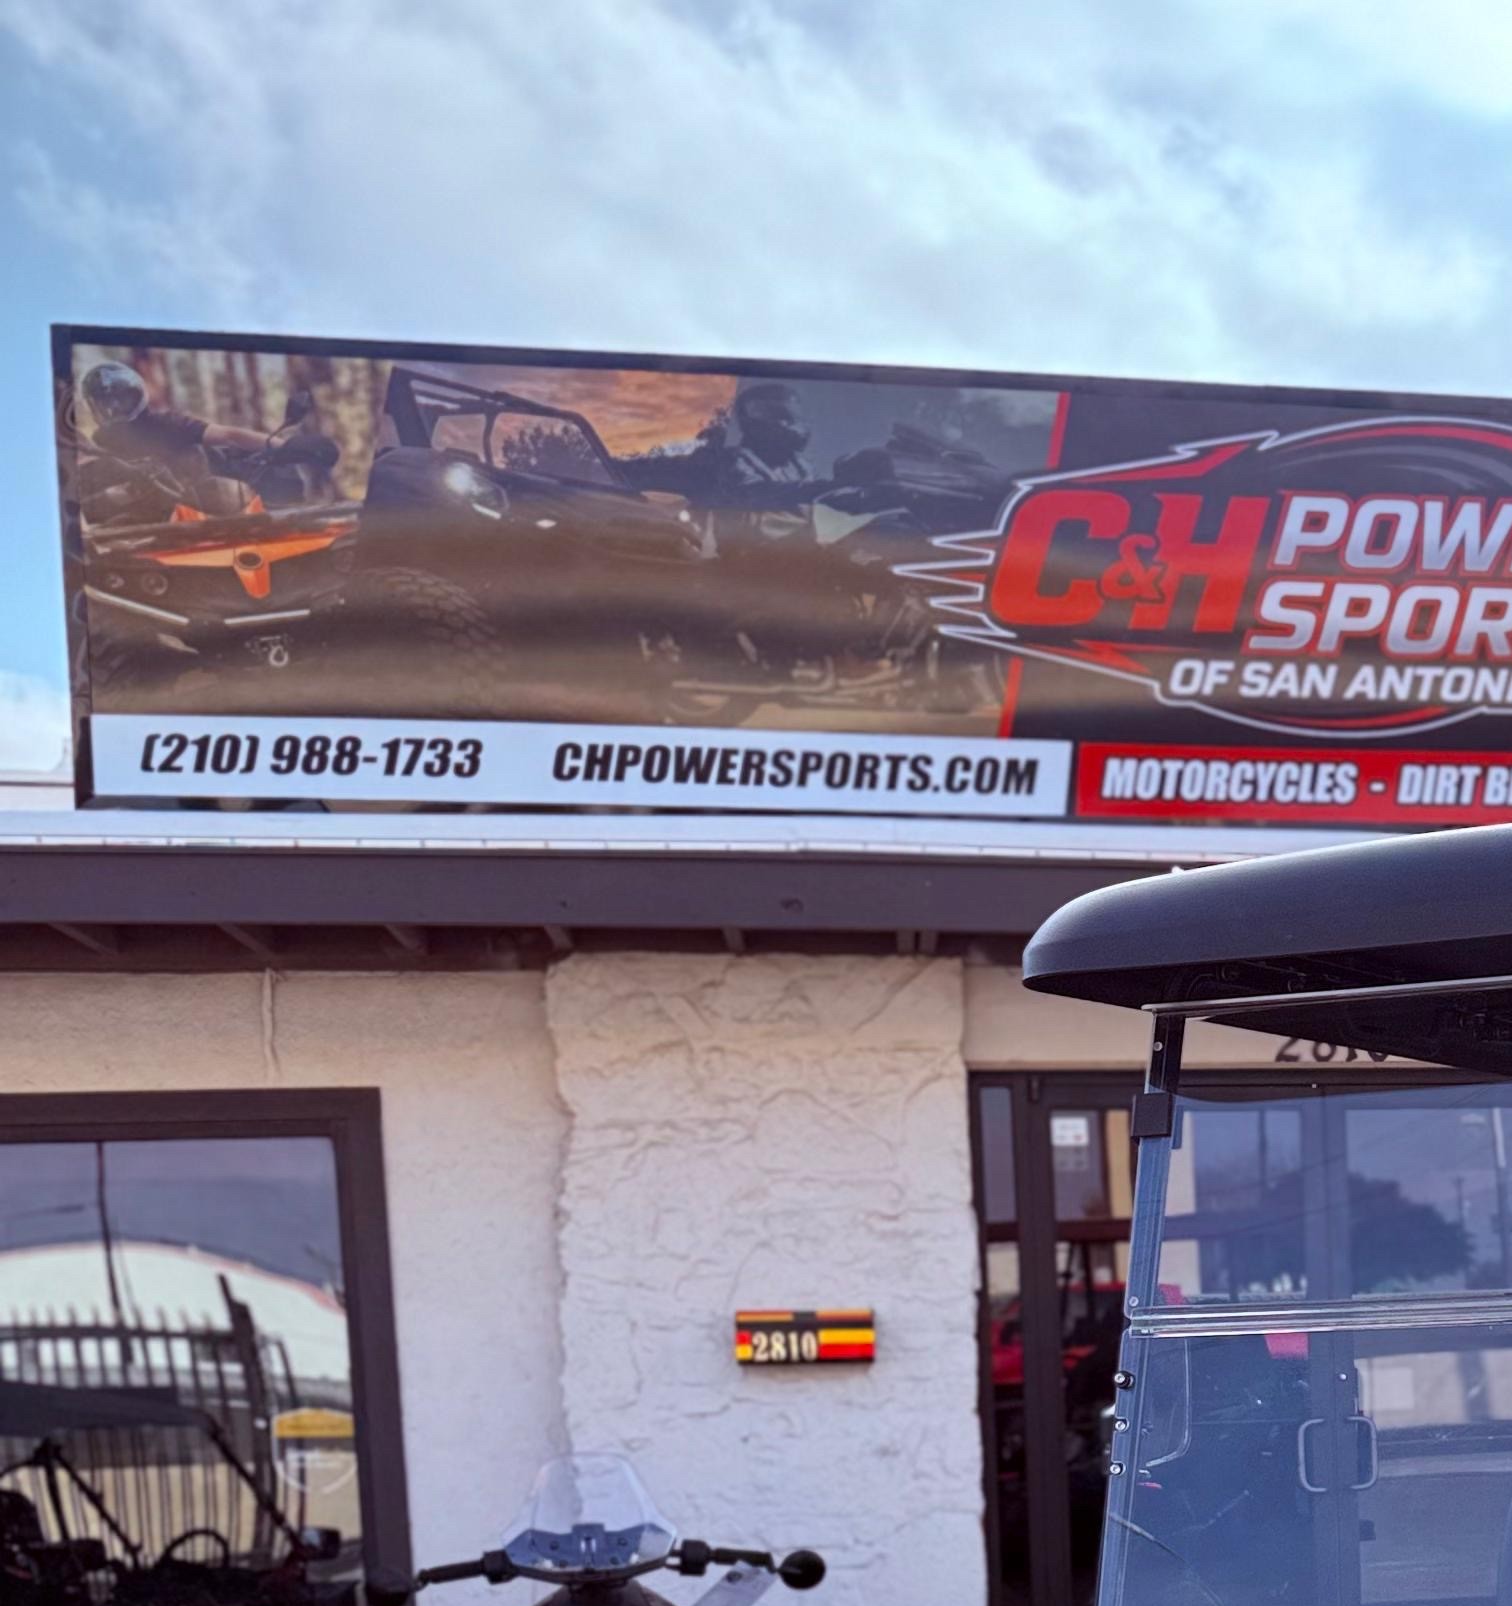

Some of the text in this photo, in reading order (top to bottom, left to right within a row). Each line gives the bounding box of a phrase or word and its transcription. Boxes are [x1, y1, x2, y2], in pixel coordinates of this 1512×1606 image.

[991, 488, 1271, 633] C&H
[1169, 659, 1230, 695] OF
[1238, 661, 1340, 700] SAN
[140, 732, 483, 778] (210) 988-1733
[551, 741, 1039, 796] CHPOWERSPORTS.COM
[1101, 757, 1359, 803] MOTORCYCLES
[1396, 763, 1480, 804] DIRT
[752, 1330, 818, 1362] 2810
